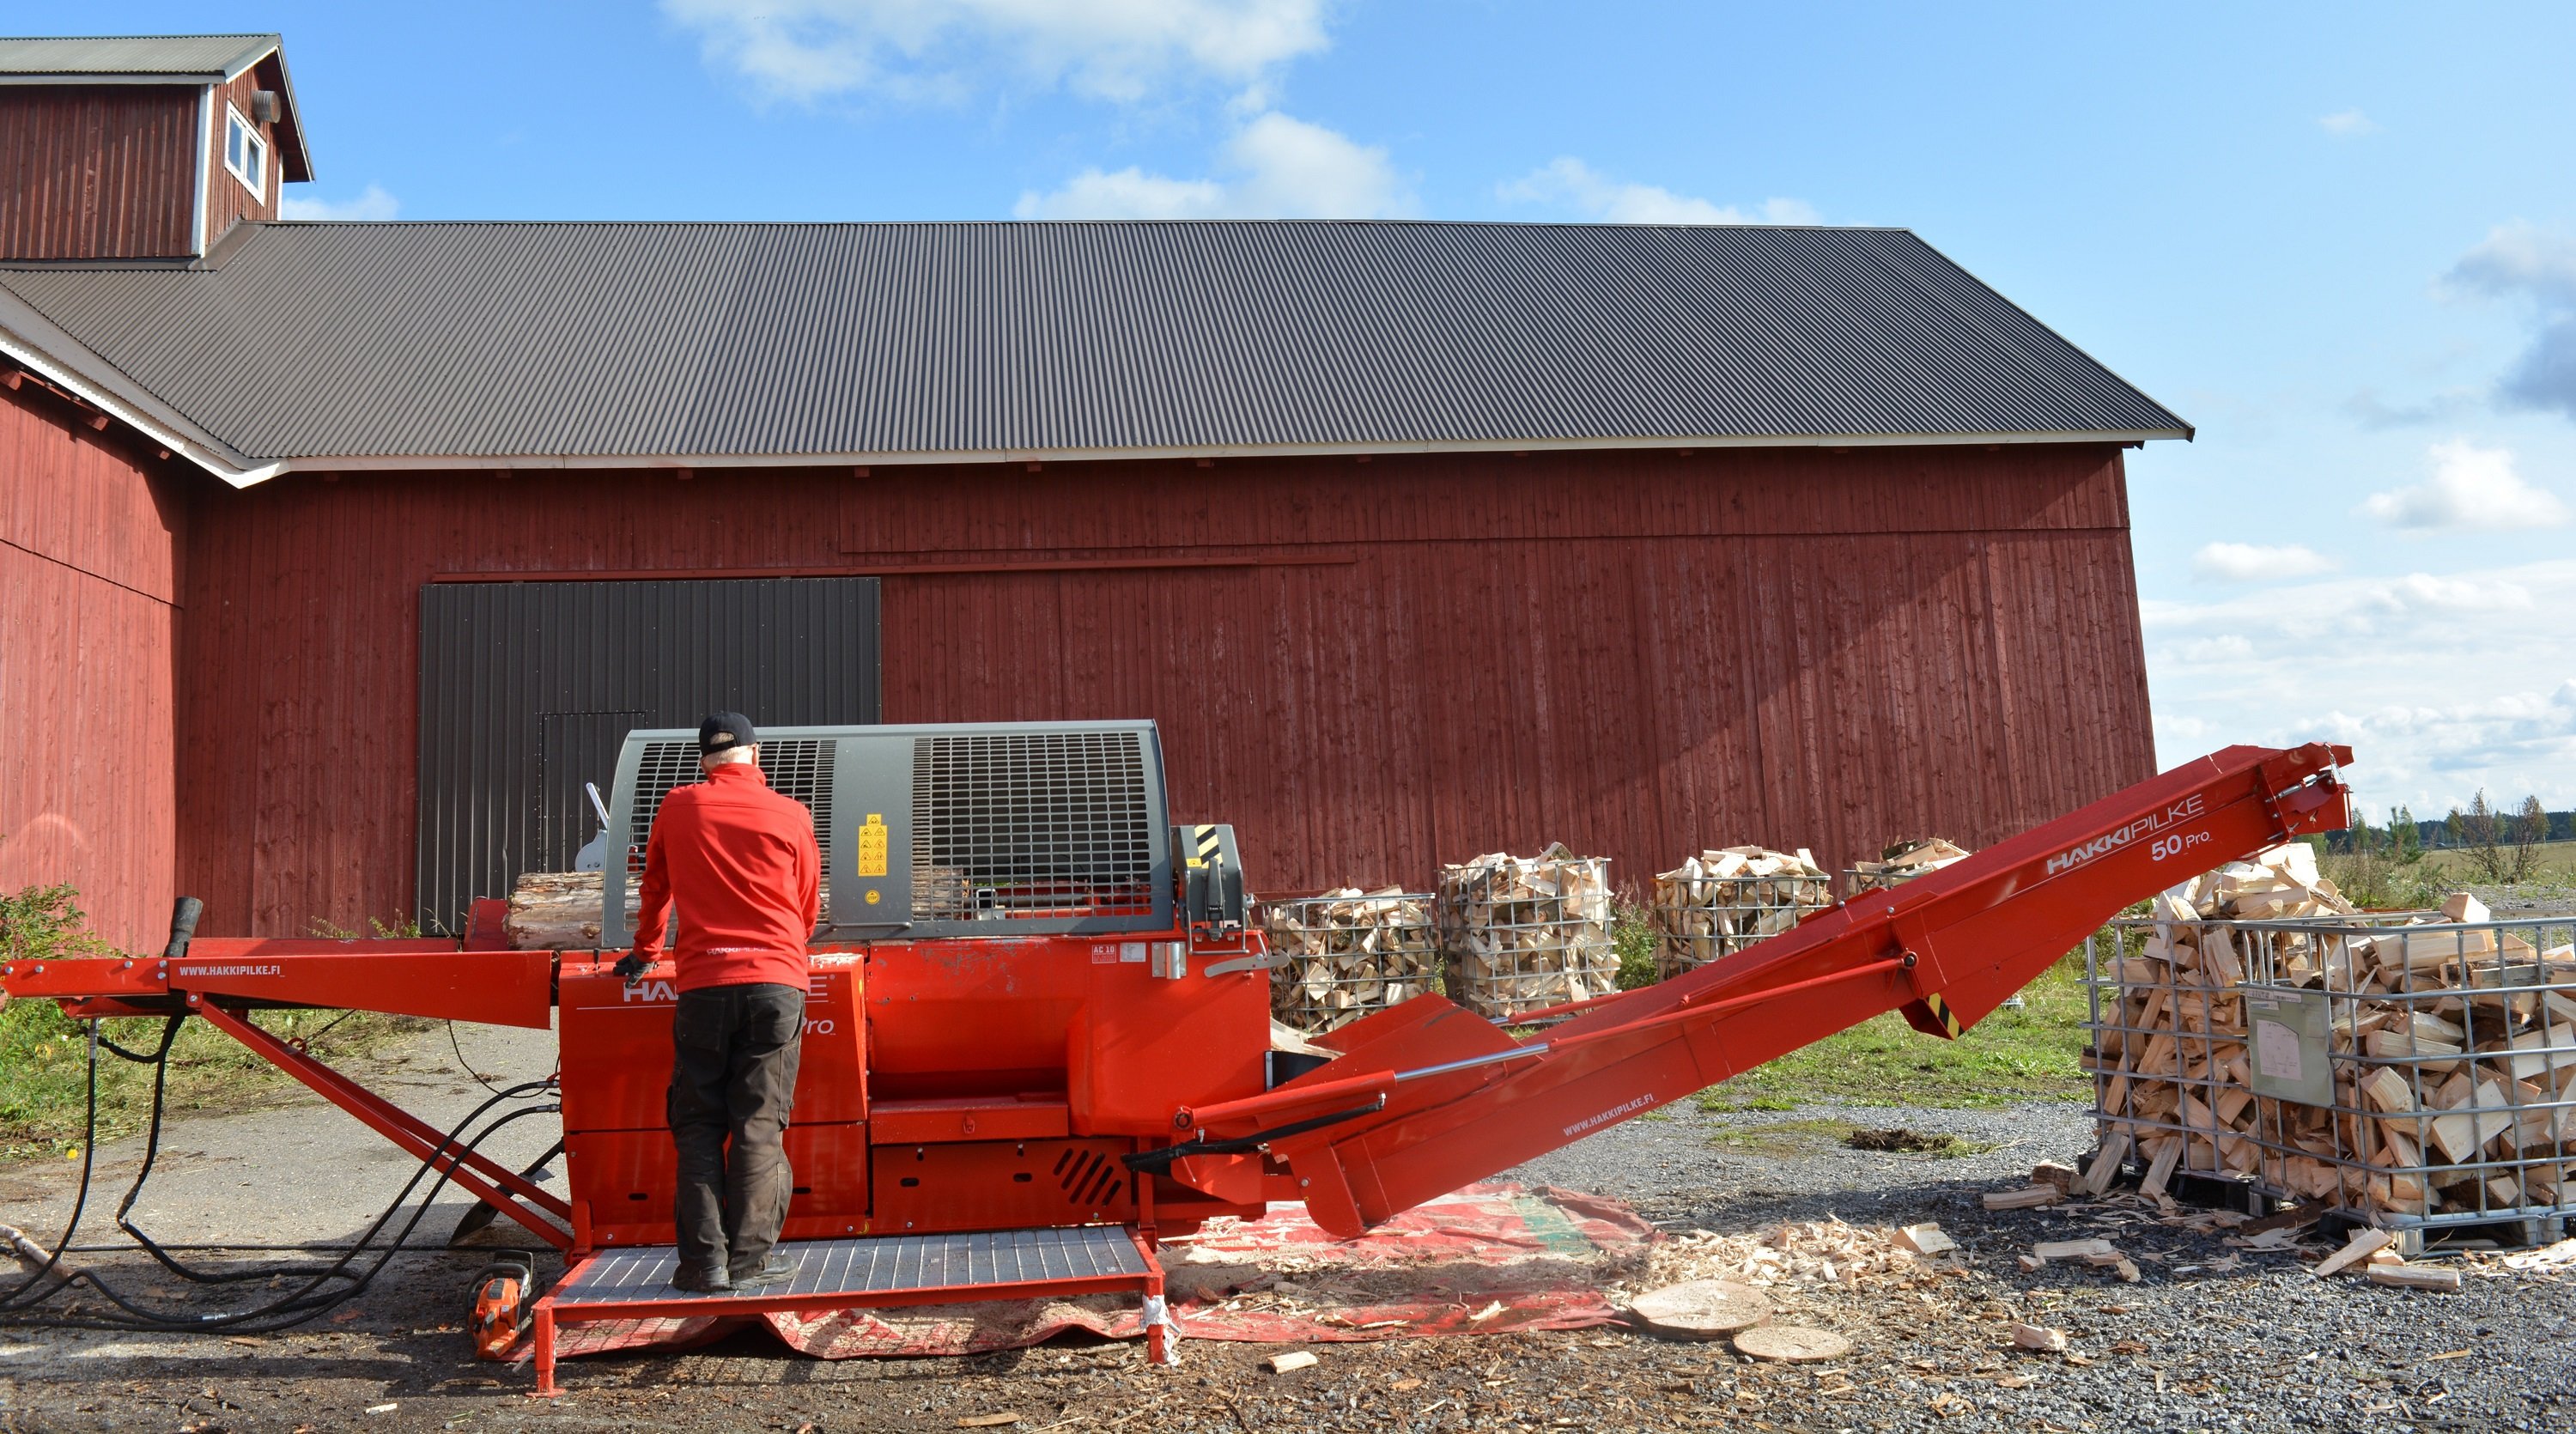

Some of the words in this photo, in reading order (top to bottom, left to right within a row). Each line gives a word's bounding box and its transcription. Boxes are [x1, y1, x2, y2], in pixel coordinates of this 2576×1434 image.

[2046, 793, 2204, 875] HAKKIPILKE
[2151, 834, 2182, 861] 50
[2185, 830, 2210, 848] Pro
[179, 965, 281, 976] WWW.HAKKIPILKE.FI
[1563, 1092, 1655, 1137] WWW.HAKKIPILKE.FI
